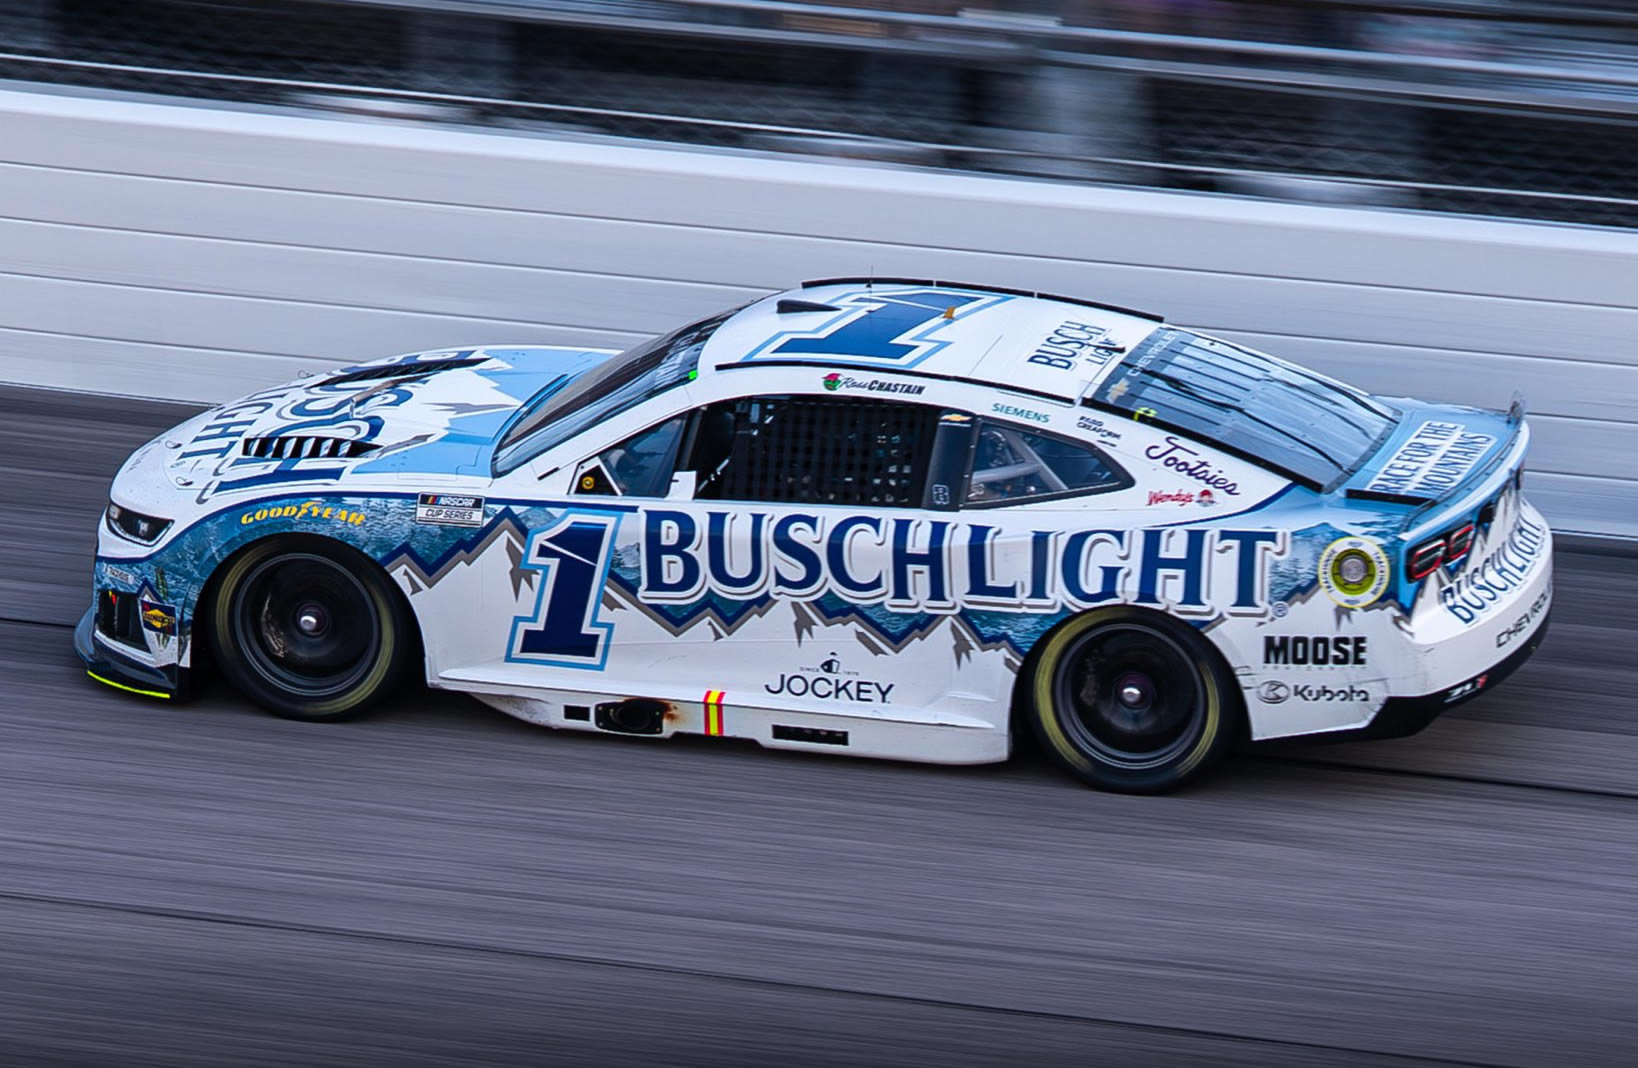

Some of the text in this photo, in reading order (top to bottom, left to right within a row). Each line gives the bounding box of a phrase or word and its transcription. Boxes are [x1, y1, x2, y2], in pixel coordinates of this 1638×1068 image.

[743, 286, 1003, 367] 1
[1026, 320, 1107, 371] BUSCH
[867, 379, 926, 395] CHASTAIN
[991, 402, 1051, 424] SIEMENS
[1145, 436, 1240, 496] Tootsies
[1370, 422, 1458, 493] RACE FOR THE
[1411, 432, 1492, 494] MOUNTAINS
[240, 501, 365, 526] GOODYEAR
[426, 508, 473, 520] CUP SERIES
[439, 496, 475, 507] NASCAR
[508, 511, 619, 667] 1
[1263, 635, 1367, 665] MOOSE
[764, 673, 895, 703] JOCKEY
[1293, 684, 1370, 702] Kubota
